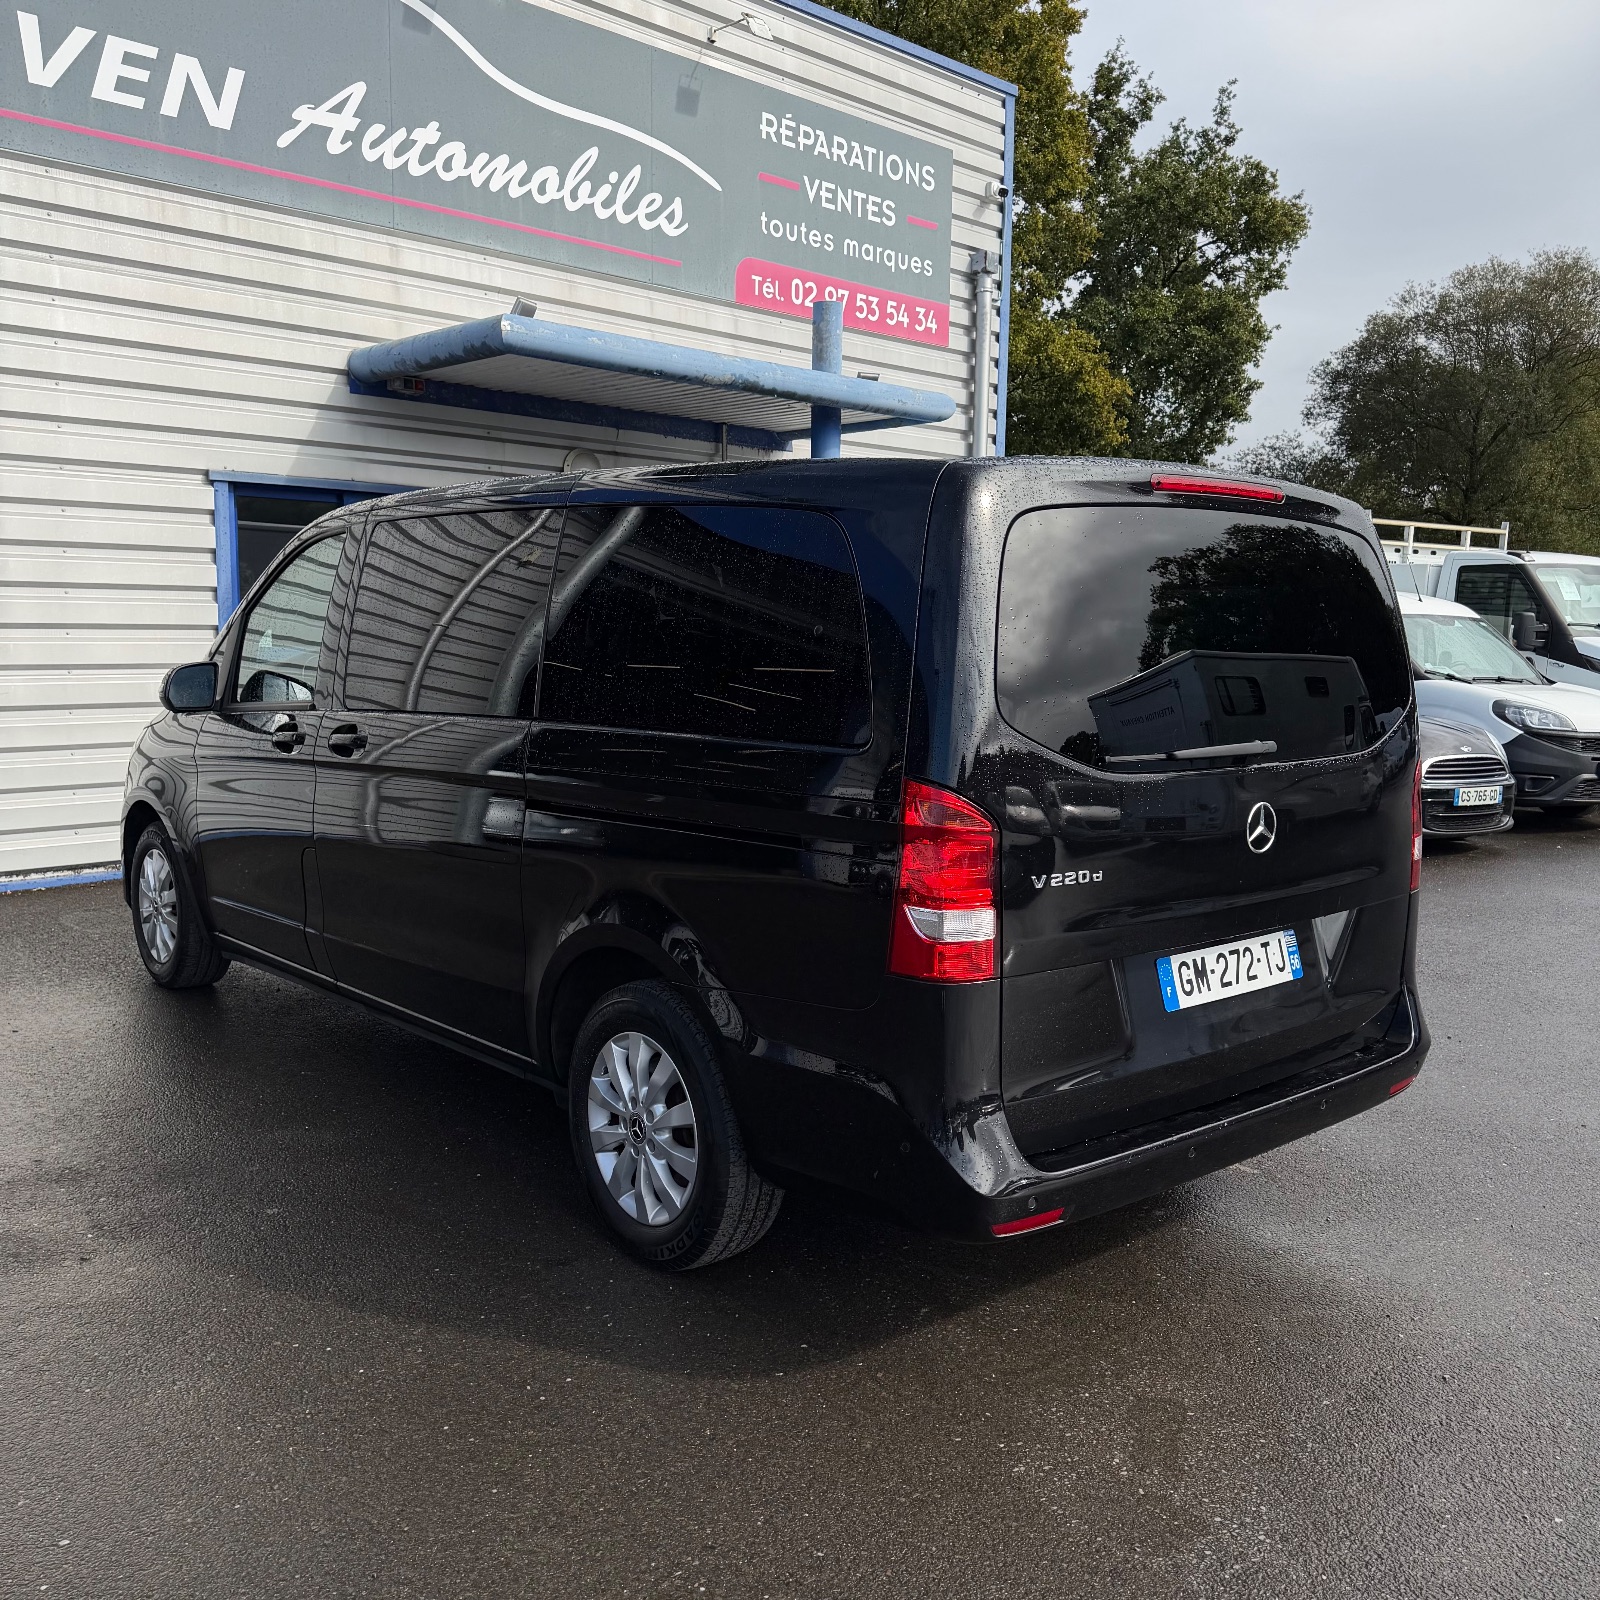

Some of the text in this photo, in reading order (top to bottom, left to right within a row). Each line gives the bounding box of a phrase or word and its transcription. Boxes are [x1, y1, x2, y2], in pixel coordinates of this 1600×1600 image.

[17, 10, 689, 237] VEN Automobiles
[760, 111, 935, 191] RÉPARATIONS
[803, 175, 896, 227] VENTES
[761, 211, 933, 277] toutes marques
[751, 275, 785, 302] Tél.
[791, 278, 818, 308] 02
[855, 293, 880, 322] 53
[886, 301, 909, 328] 54
[915, 307, 938, 334] 34
[1177, 938, 1286, 997] GM-272-TJ
[1290, 953, 1301, 971] 56
